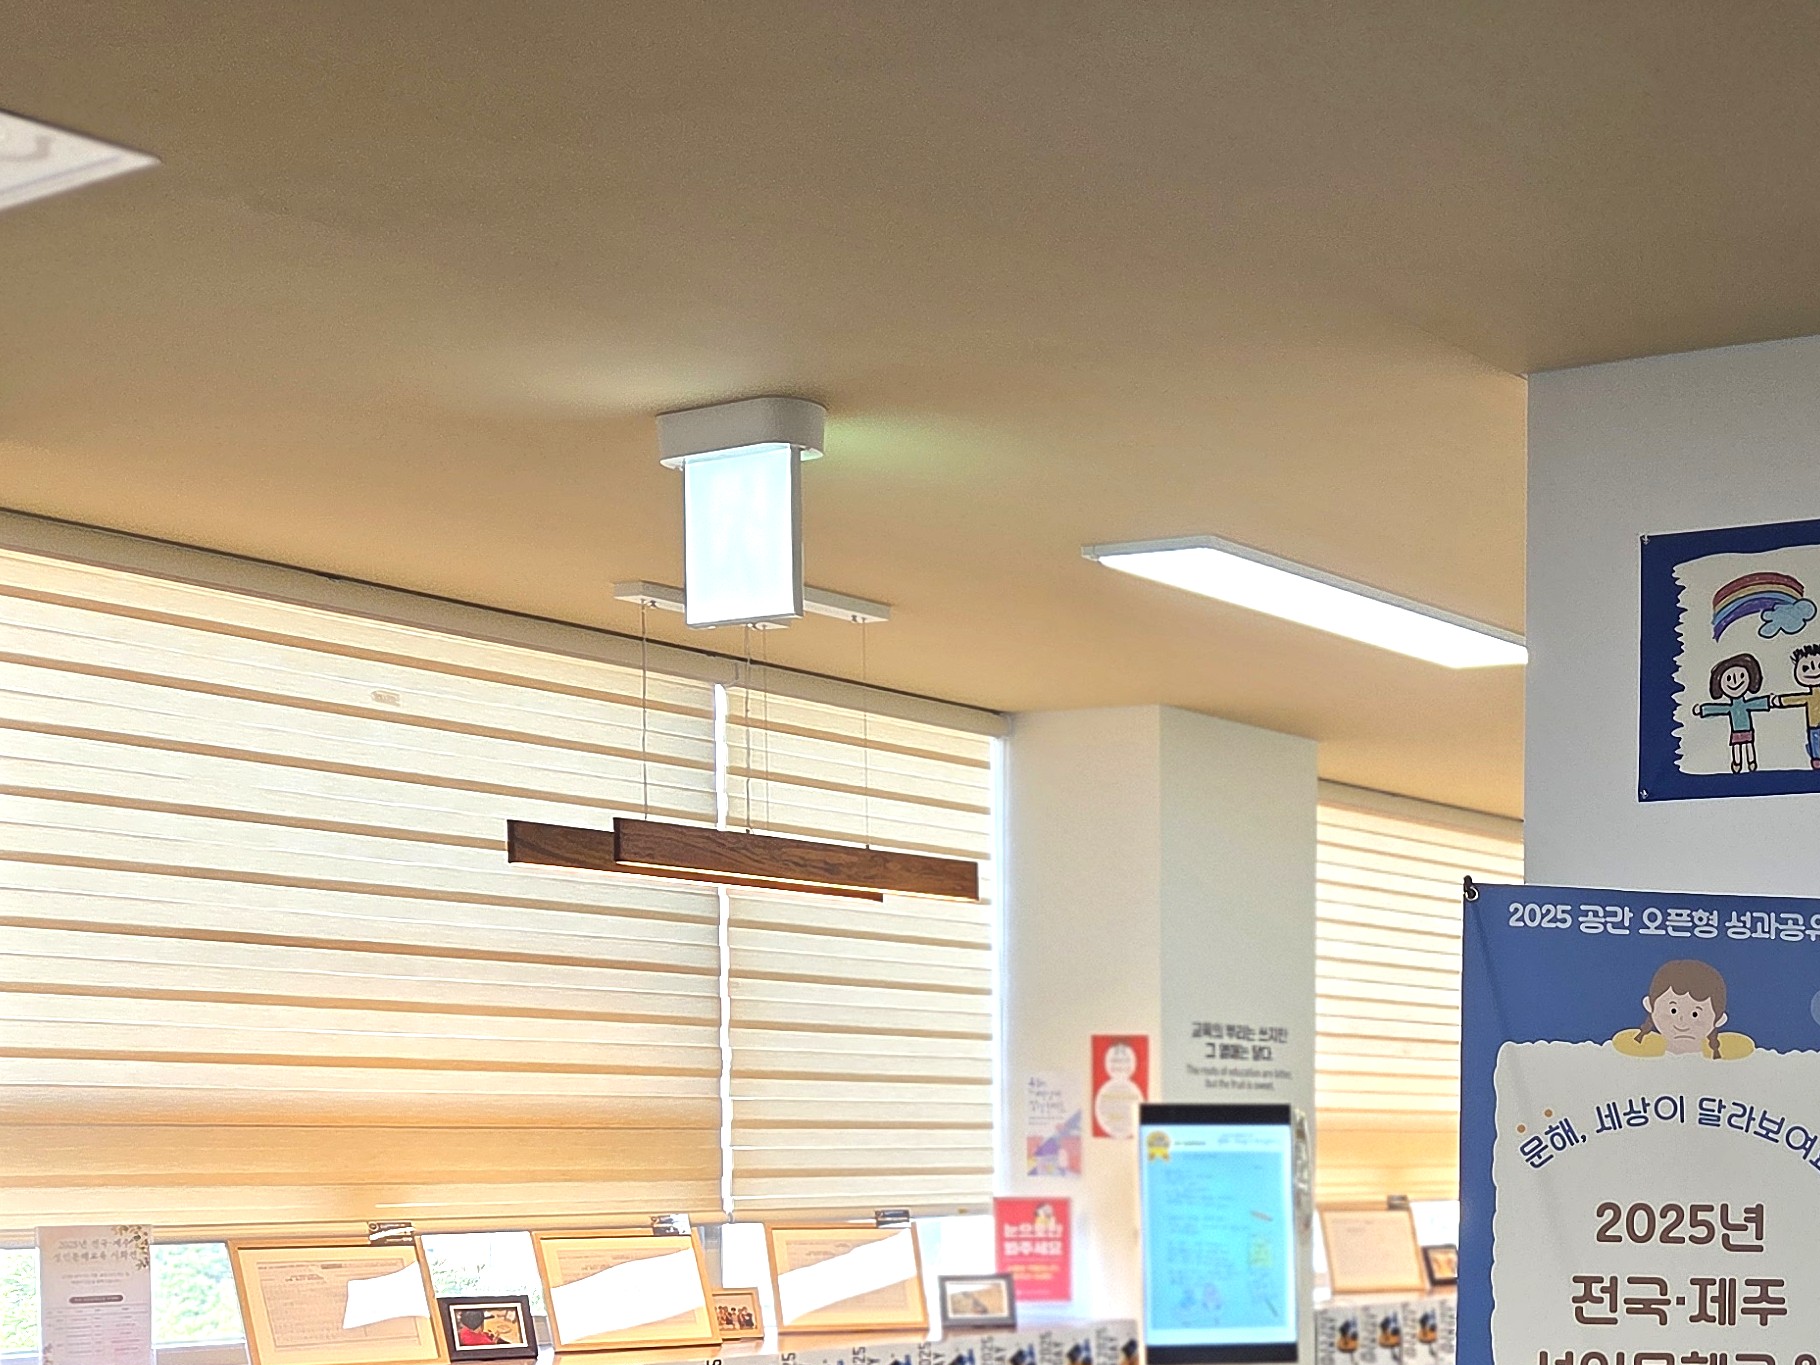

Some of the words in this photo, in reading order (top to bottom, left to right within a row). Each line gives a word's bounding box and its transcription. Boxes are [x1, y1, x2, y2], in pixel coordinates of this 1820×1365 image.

[1508, 903, 1572, 928] 2025
[1578, 904, 1633, 935] 공간
[1638, 908, 1719, 938] 오픈형
[1205, 1042, 1216, 1058] 그
[1519, 1118, 1588, 1169] 문해,
[1595, 1095, 1685, 1134] 세상이
[1596, 1202, 1765, 1252] 2025년
[1571, 1275, 1788, 1326] 전국·제주
